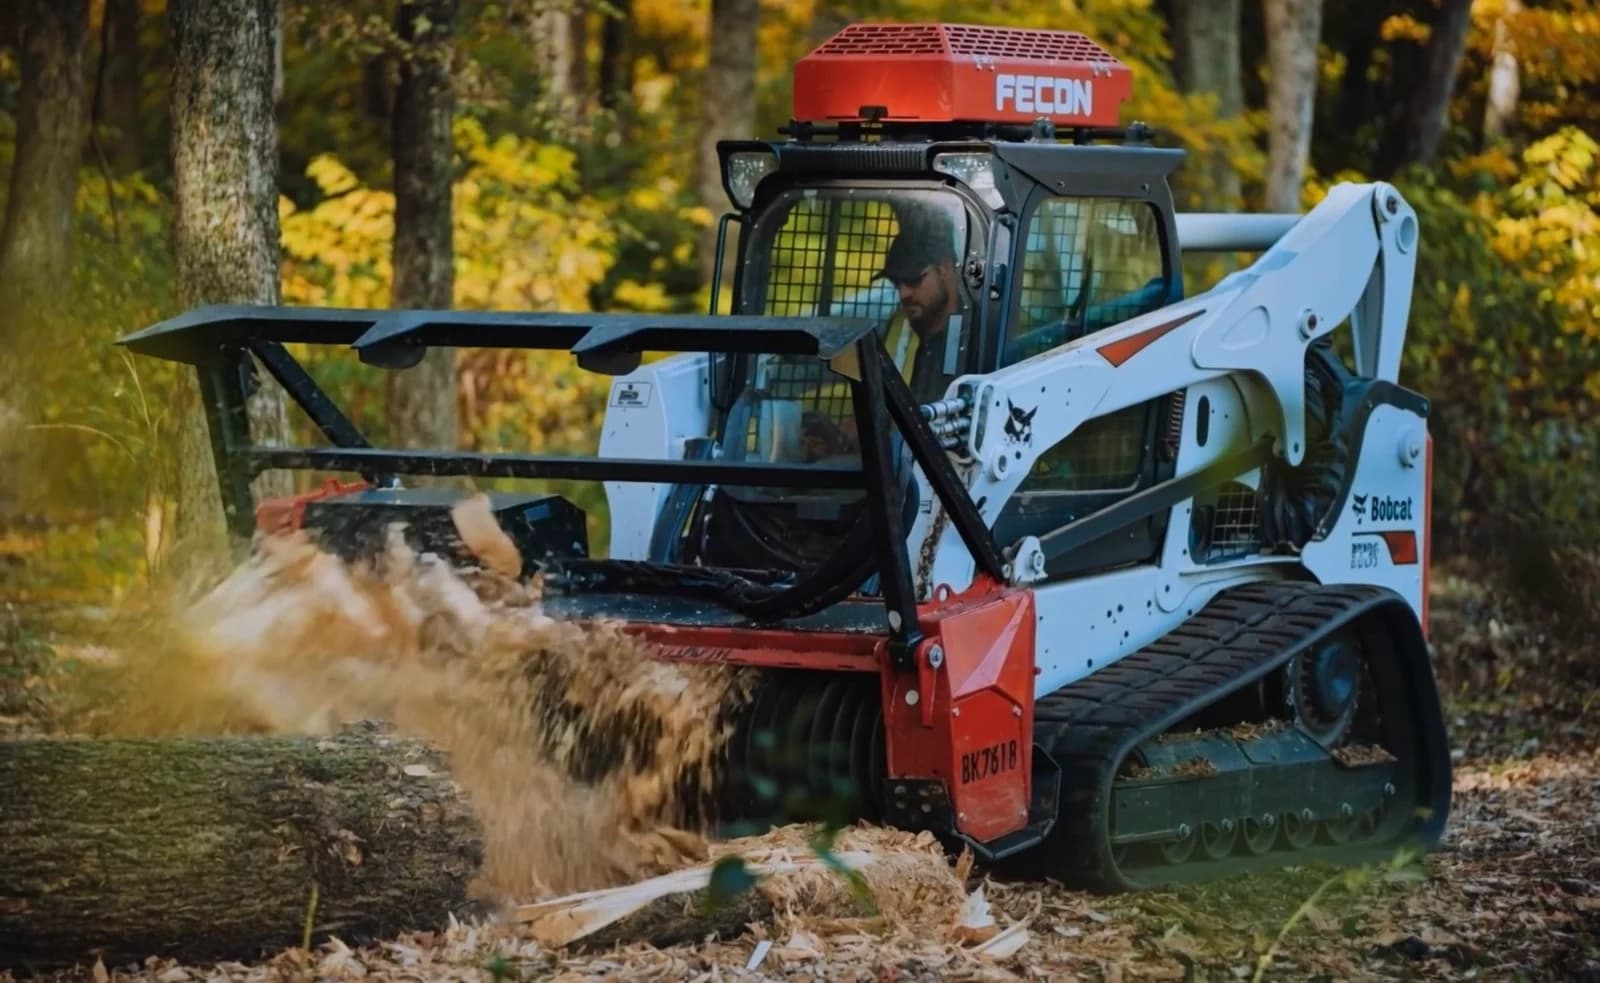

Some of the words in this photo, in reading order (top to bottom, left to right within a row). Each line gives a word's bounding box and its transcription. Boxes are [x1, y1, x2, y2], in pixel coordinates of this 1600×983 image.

[996, 74, 1092, 116] FECON
[1371, 495, 1413, 522] Bobcat
[962, 740, 1017, 785] BK7618
